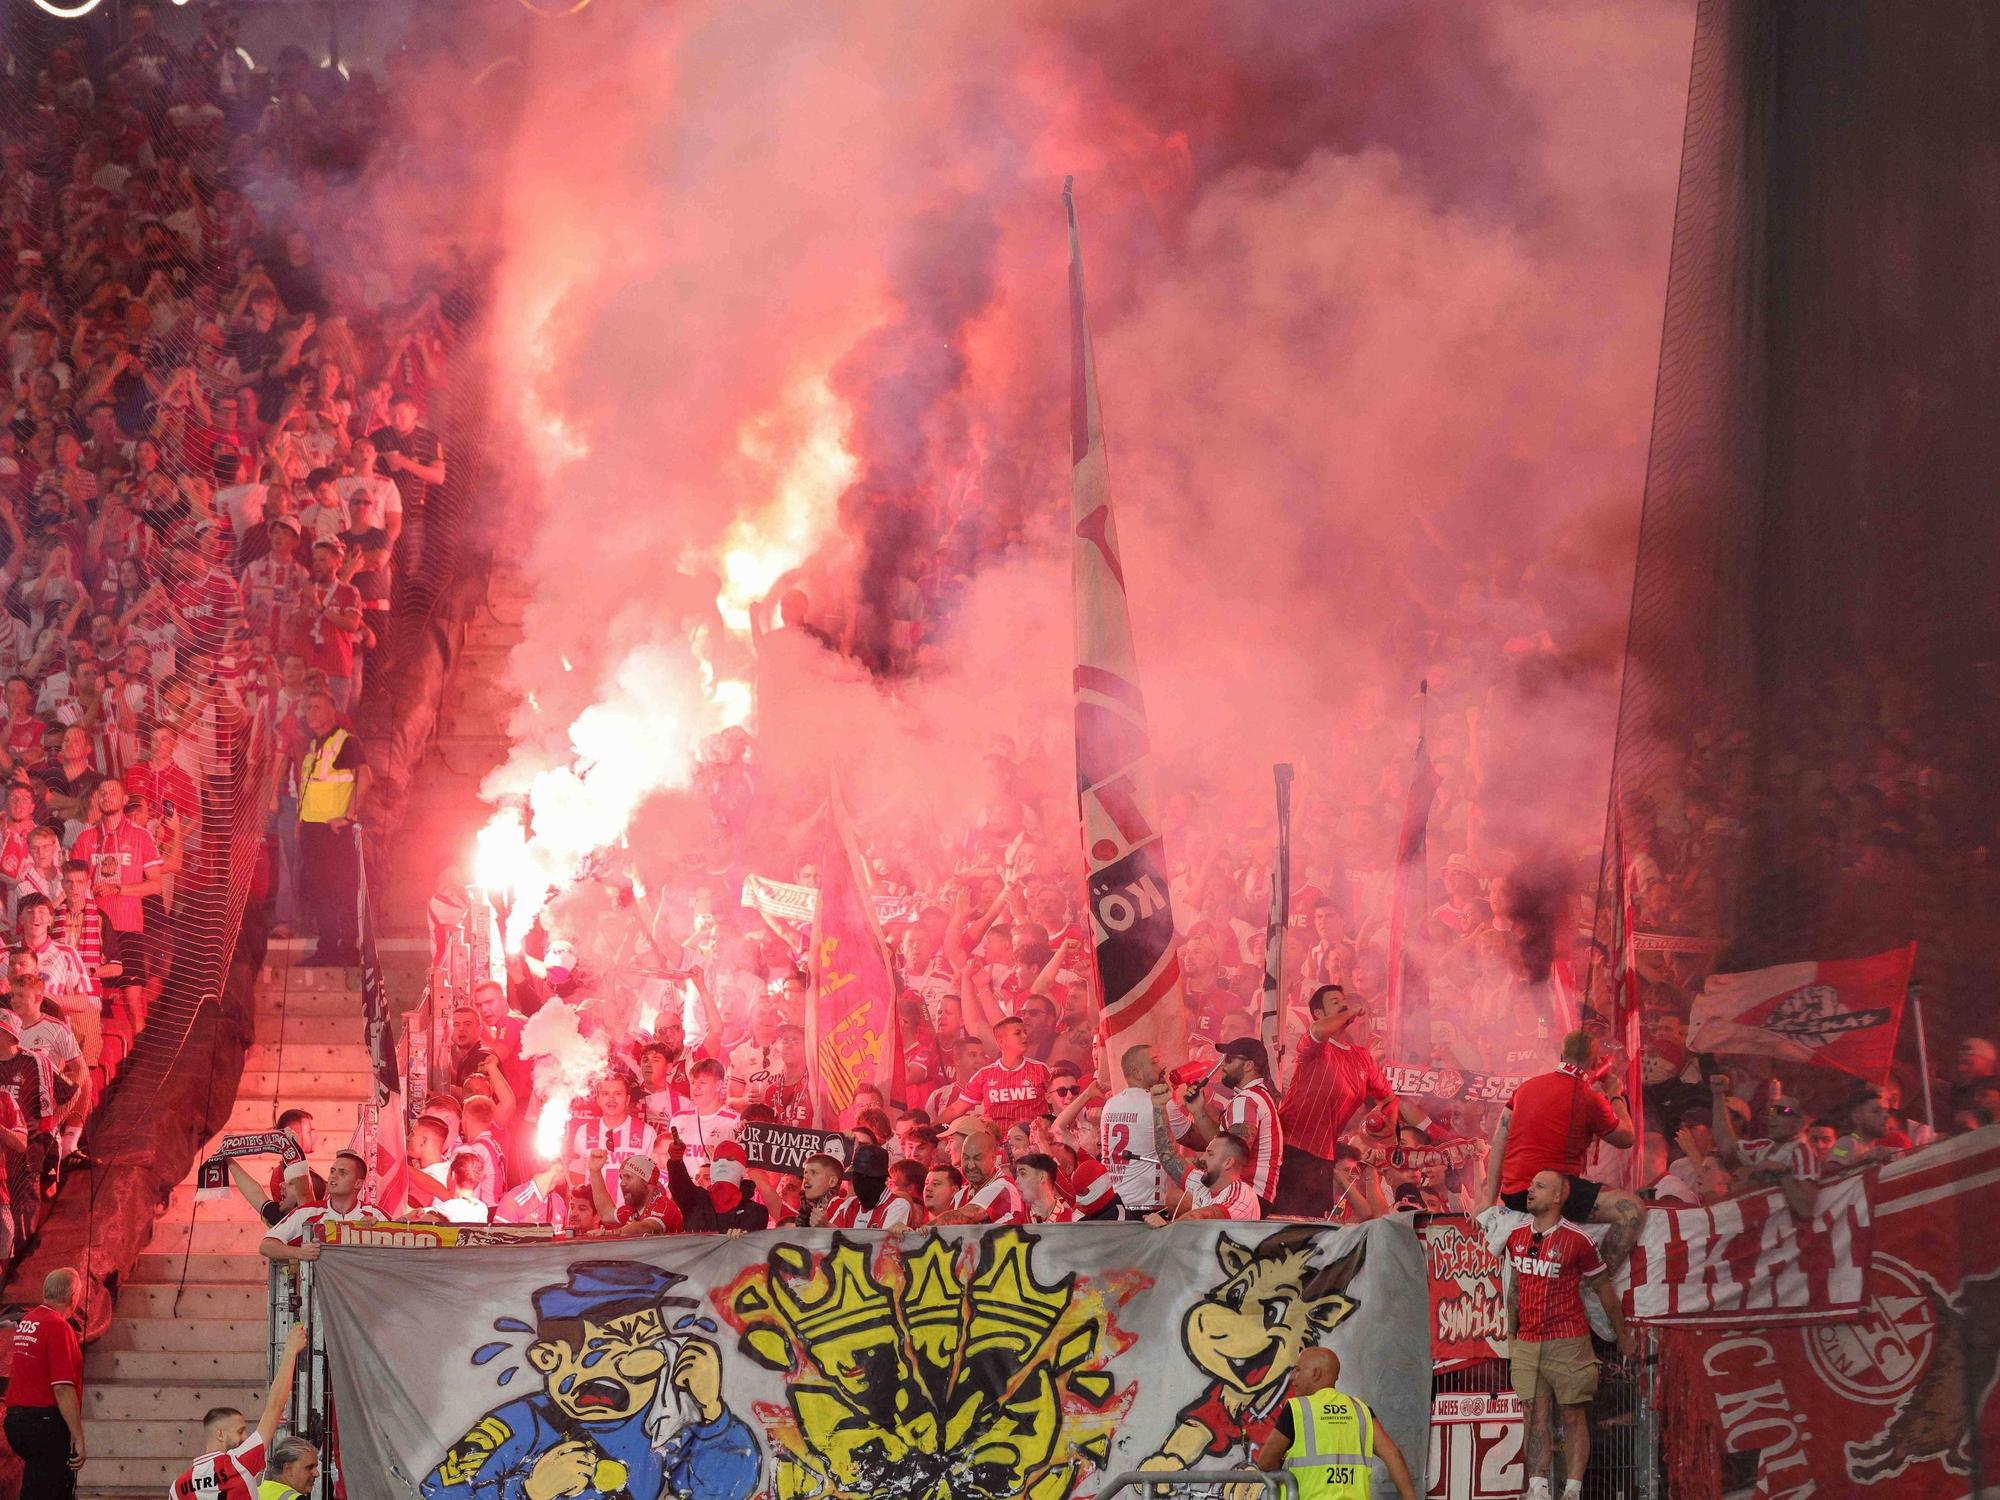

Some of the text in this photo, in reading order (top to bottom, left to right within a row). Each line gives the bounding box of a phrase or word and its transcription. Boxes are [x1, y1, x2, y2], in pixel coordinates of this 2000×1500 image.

[988, 1087, 1037, 1103] REWE
[765, 1129, 820, 1150] IMMER
[1626, 1174, 1870, 1318] IKAT
[1512, 1255, 1562, 1278] REWE
[16, 1320, 40, 1334] SDS
[1323, 1404, 1348, 1414] SDS
[1438, 1400, 1459, 1415] WEISS
[1486, 1398, 1509, 1413] UNSER
[180, 1468, 228, 1496] ULTRAS
